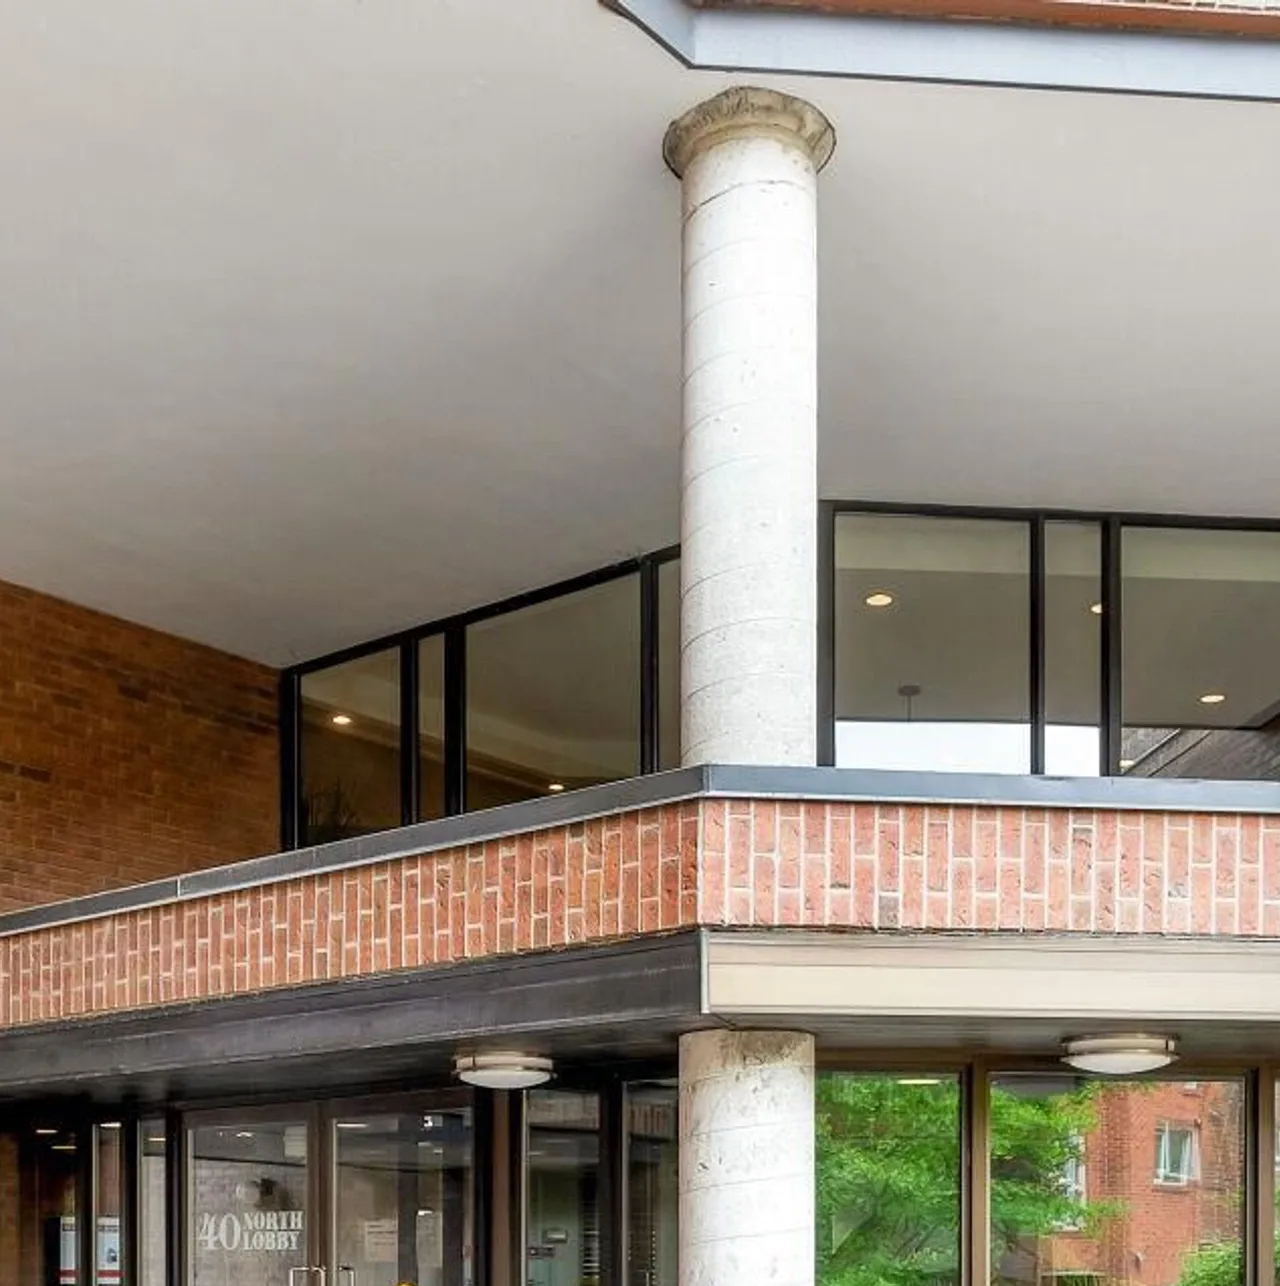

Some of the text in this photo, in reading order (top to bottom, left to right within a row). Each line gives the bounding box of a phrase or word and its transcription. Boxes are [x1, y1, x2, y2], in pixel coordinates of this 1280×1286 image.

[243, 1210, 304, 1230] NORTH
[199, 1211, 241, 1250] 40
[243, 1231, 300, 1250] LOBBY
